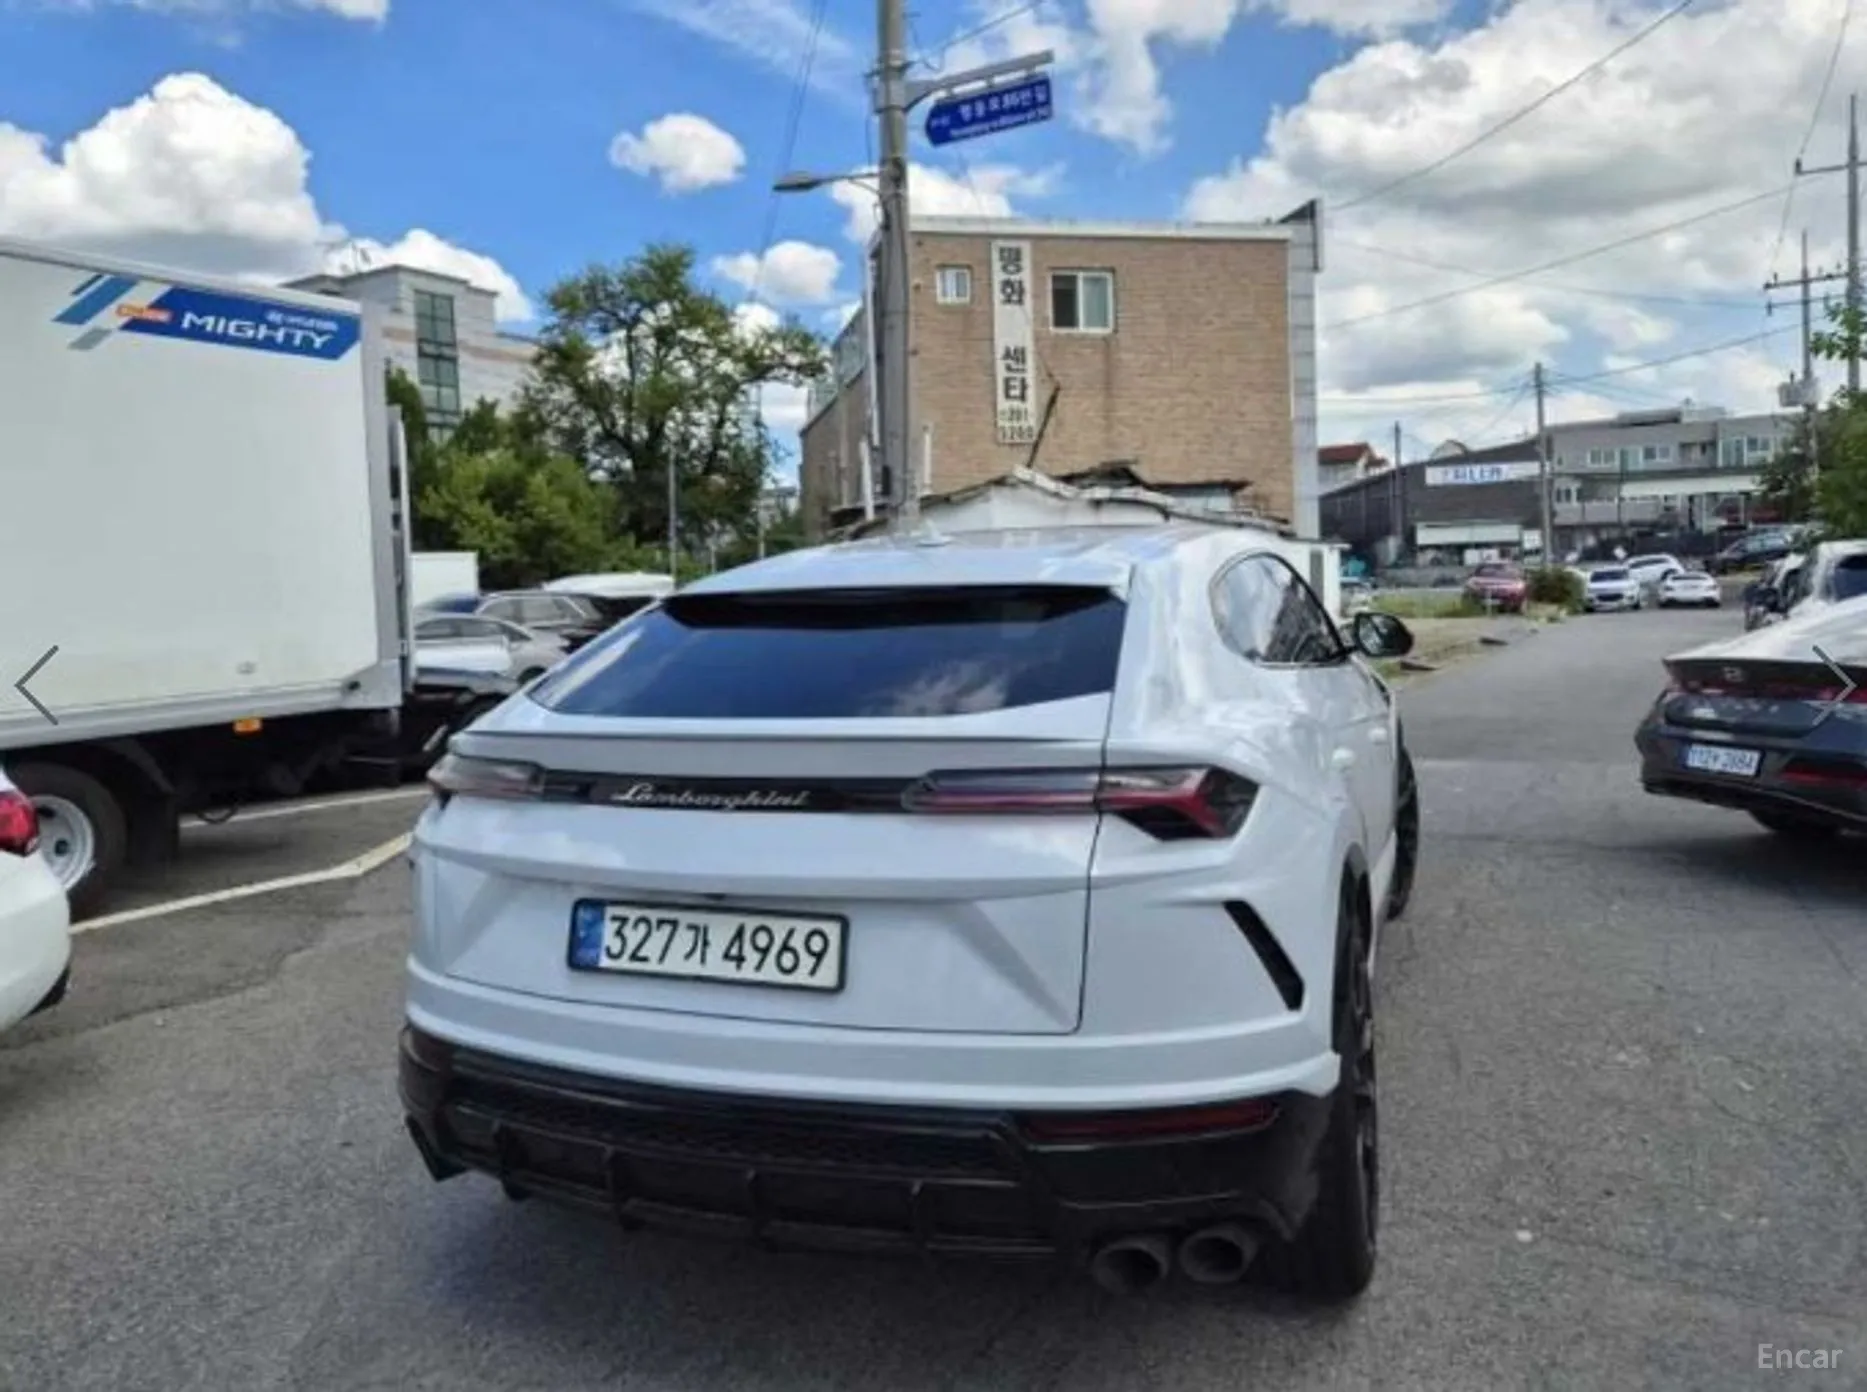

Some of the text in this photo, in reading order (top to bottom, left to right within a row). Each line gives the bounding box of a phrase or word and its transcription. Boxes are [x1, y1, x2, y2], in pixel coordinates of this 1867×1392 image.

[181, 311, 333, 349] MIGHTY
[1003, 346, 1028, 402] 센타
[609, 783, 811, 810] Lamborghini
[605, 914, 830, 977] 327가 4969
